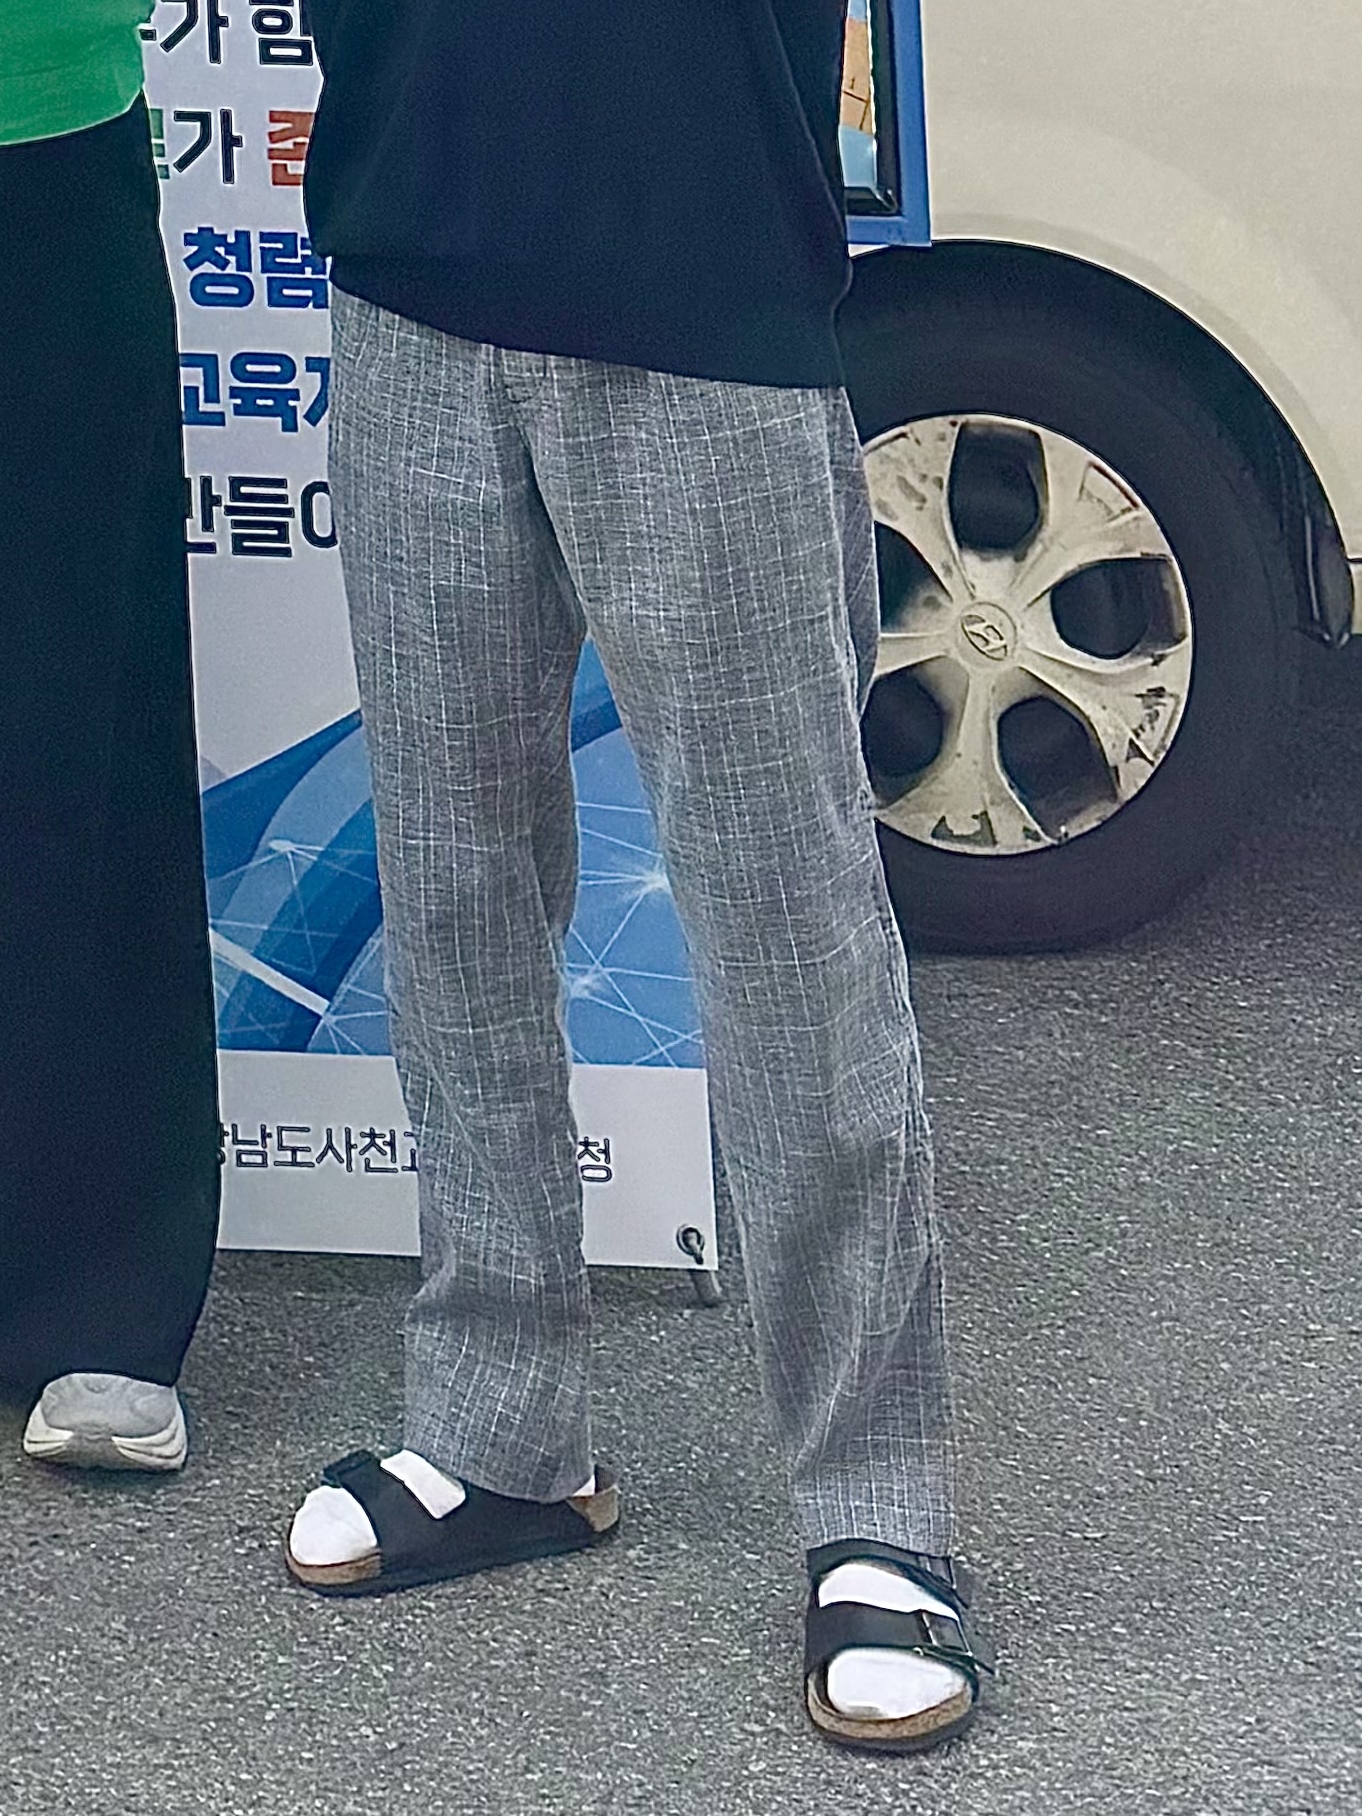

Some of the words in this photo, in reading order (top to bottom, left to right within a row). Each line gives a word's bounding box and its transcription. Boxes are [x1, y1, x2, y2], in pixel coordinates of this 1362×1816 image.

[149, 108, 244, 185] 가
[182, 226, 331, 310] 청렴
[217, 1122, 419, 1174] 남도사천
